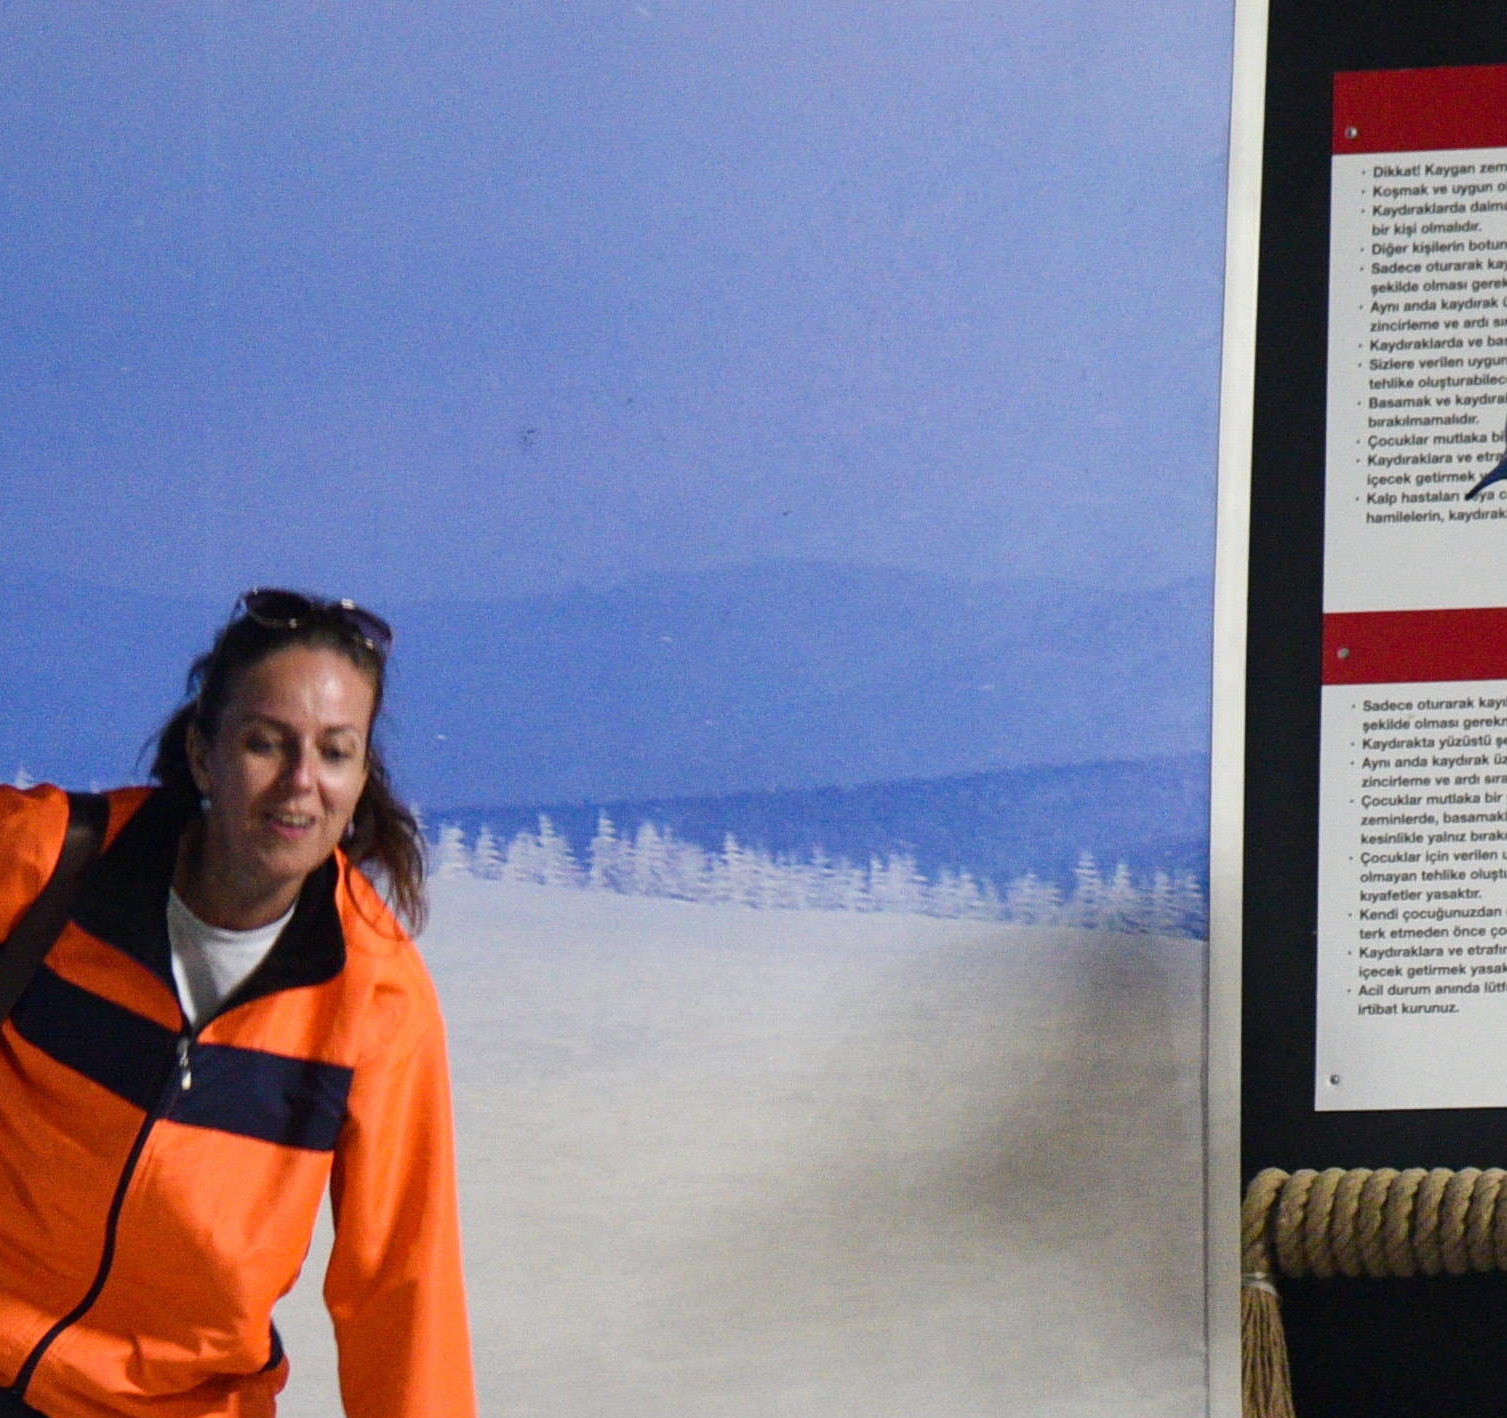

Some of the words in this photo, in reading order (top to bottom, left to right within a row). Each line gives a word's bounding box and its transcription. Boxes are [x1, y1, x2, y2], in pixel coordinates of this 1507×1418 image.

[1373, 164, 1421, 178] Dikkat!
[1425, 164, 1475, 178] Kaygan
[1372, 184, 1428, 199] Koşmak
[1432, 185, 1448, 195] ve
[1452, 183, 1493, 196] uygun
[1372, 202, 1466, 218] Kaydıraklarda
[1371, 224, 1390, 236] bir
[1393, 223, 1417, 237] kişi
[1420, 220, 1482, 234] olmalıdır.
[1371, 242, 1408, 257] Diğer
[1412, 241, 1465, 256] kişilerin
[1371, 262, 1422, 275] Sadece
[1425, 259, 1483, 272] oturarak
[1371, 281, 1419, 297] şekilde
[1423, 279, 1468, 292] olması
[1363, 699, 1413, 712] Sadece
[1417, 697, 1474, 711] oturarak
[1362, 737, 1435, 752] Kaydırakta
[1439, 734, 1492, 750] yüzüstü
[1360, 871, 1417, 884] olmayan
[1421, 869, 1466, 881] tehlike
[1360, 889, 1422, 904] kıyafetler
[1426, 888, 1481, 903] yasaktır.
[1359, 945, 1444, 961] Kaydıraklara
[1448, 947, 1463, 956] ve
[1359, 965, 1402, 980] içecek
[1407, 963, 1466, 979] getirmek
[1358, 984, 1384, 996] Acil
[1387, 984, 1431, 996] durum
[1435, 982, 1480, 995] anında
[1358, 1003, 1398, 1015] irtibat
[1401, 1003, 1459, 1014] kurunuz.
